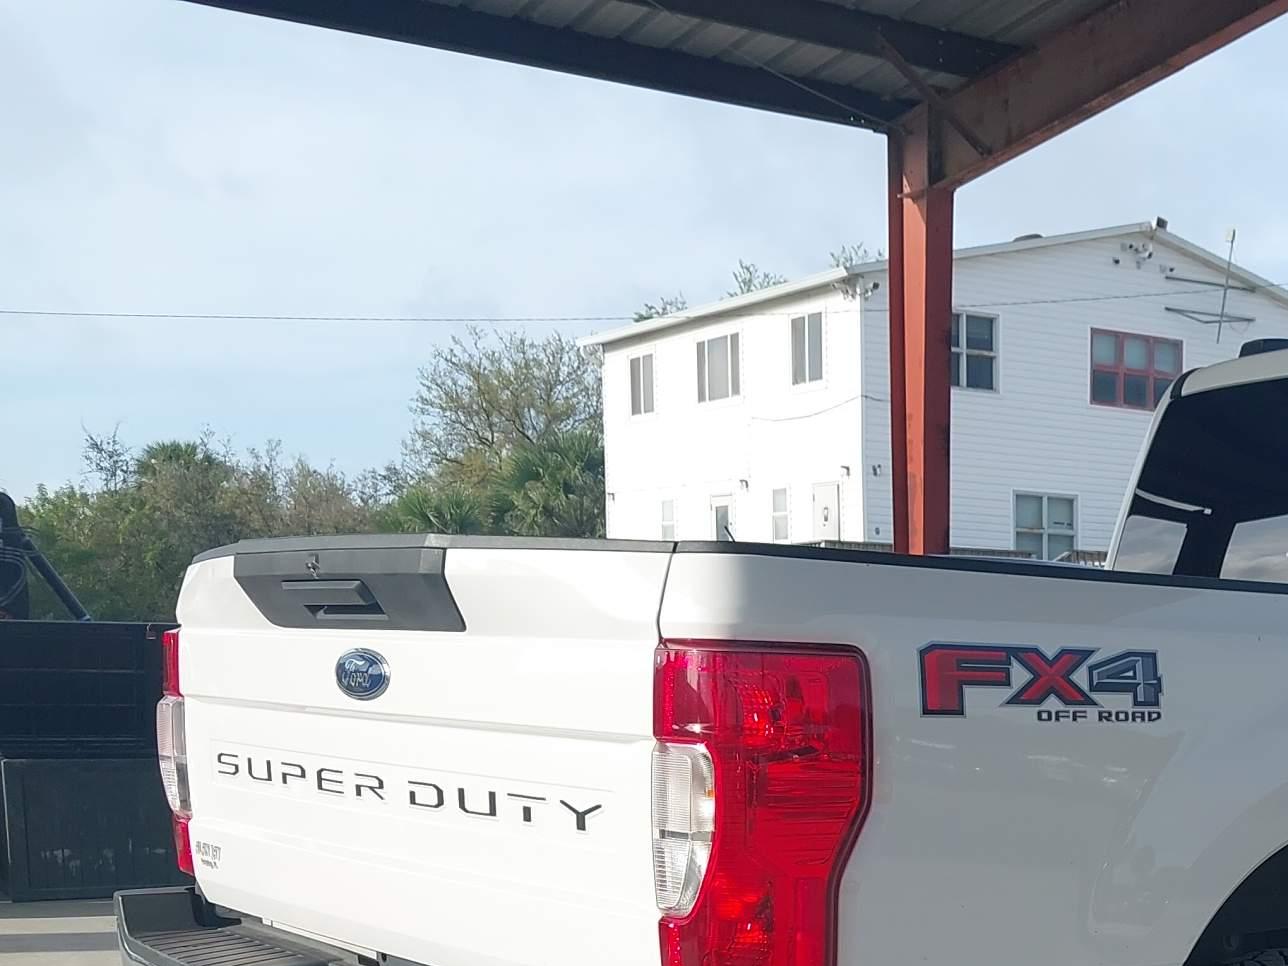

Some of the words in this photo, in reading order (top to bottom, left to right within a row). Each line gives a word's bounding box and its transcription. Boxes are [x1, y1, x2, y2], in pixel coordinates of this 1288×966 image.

[918, 641, 1164, 717] FX4
[1036, 709, 1088, 722] OFF
[1097, 710, 1162, 723] ROAD
[217, 752, 385, 801] SUPER
[407, 780, 602, 832] DUTY
